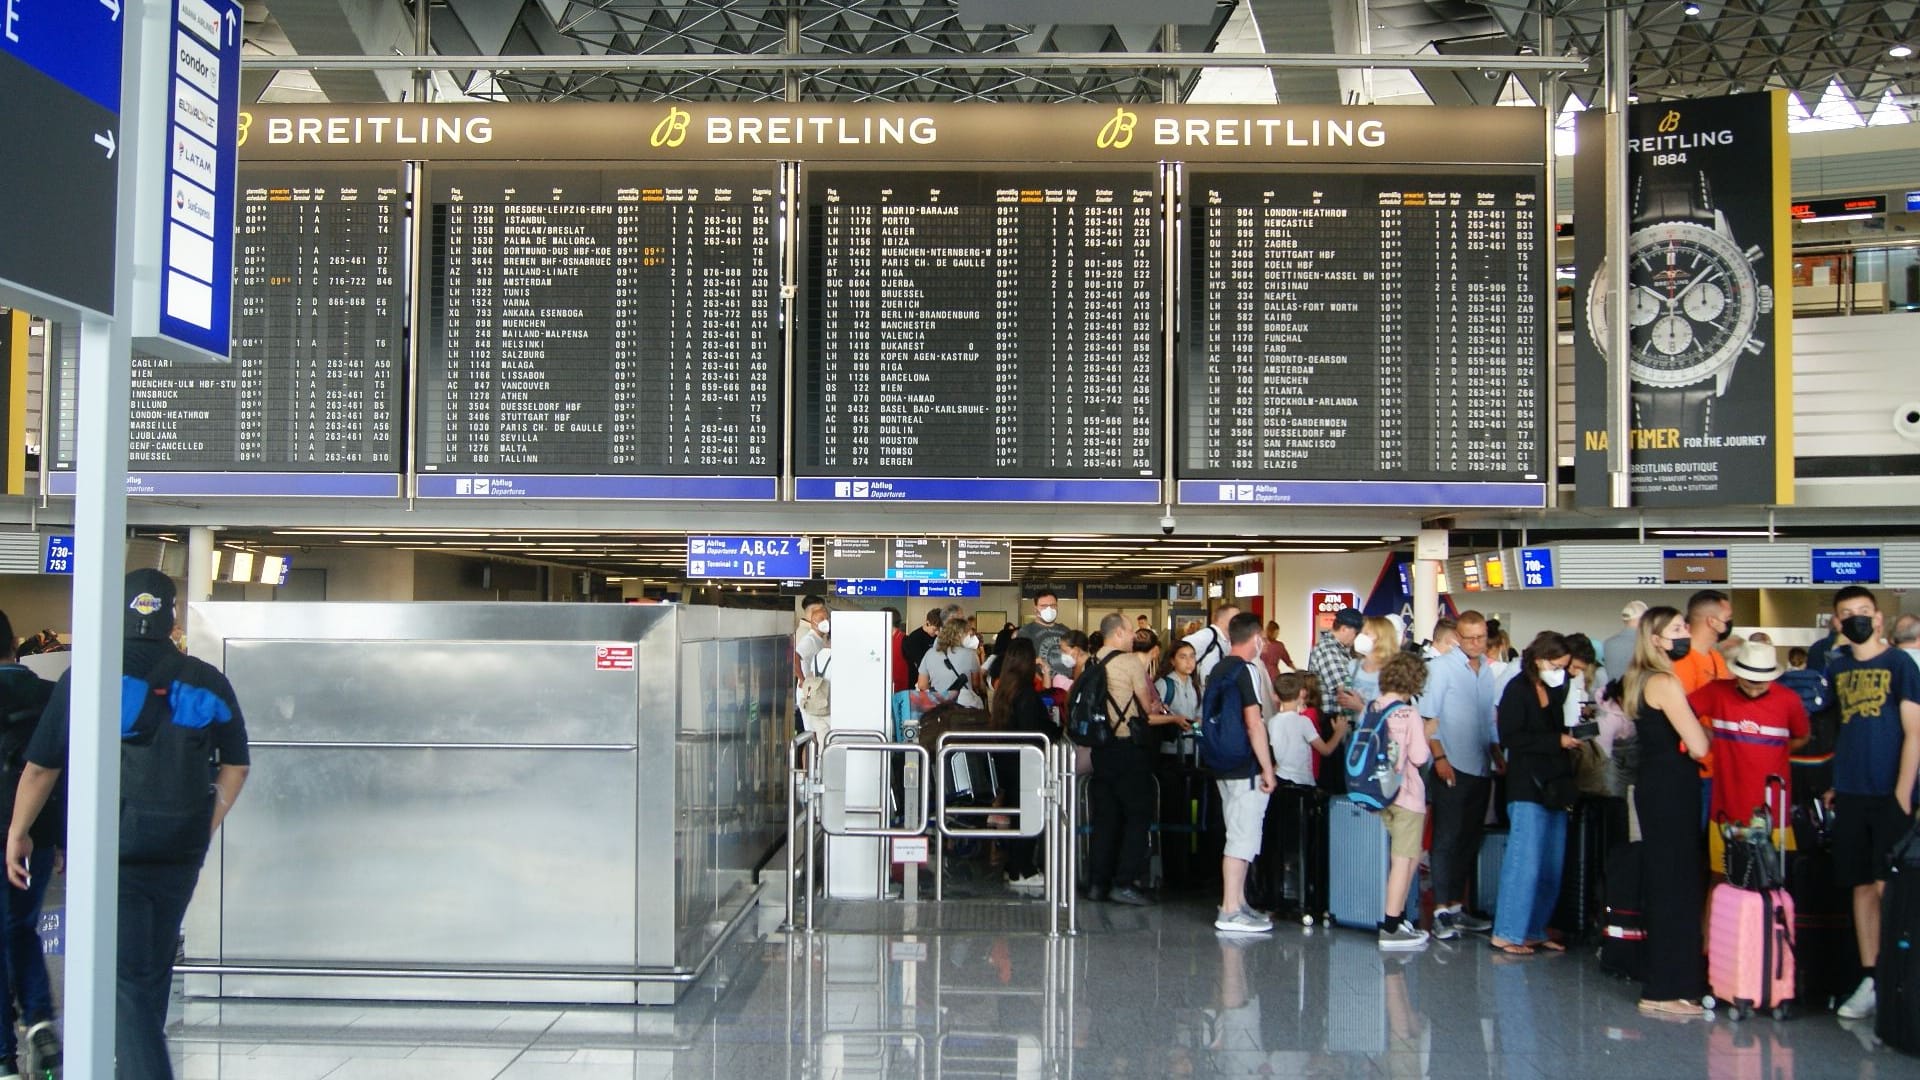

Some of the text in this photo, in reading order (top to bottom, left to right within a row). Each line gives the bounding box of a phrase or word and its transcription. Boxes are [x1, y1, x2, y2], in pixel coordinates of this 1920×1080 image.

[181, 48, 209, 77] condor
[267, 116, 493, 145] BREITLING
[705, 116, 938, 145] BREITLING
[1153, 117, 1386, 147] BREITLING
[1629, 129, 1734, 153] REITLING
[185, 149, 212, 174] LATAM
[1652, 152, 1688, 167] 1884
[1585, 428, 1767, 451] NATIMER FOR THE JOURNEY
[1675, 462, 1718, 473] BOUTIQUE
[491, 479, 513, 488] Abflug
[871, 482, 893, 491] Abflug
[1255, 484, 1278, 493] Abflug
[491, 487, 526, 496] Departures
[871, 490, 906, 499] Departures
[706, 539, 726, 548] Abflug
[51, 546, 73, 558] 730-
[706, 547, 738, 555] Departures
[50, 559, 67, 571] 753
[706, 560, 731, 568] Terminal
[1525, 560, 1545, 572] 700-
[1526, 573, 1542, 585] 726
[1637, 576, 1657, 584] 722
[1785, 576, 1804, 584] 721
[1325, 594, 1342, 604] ATM
